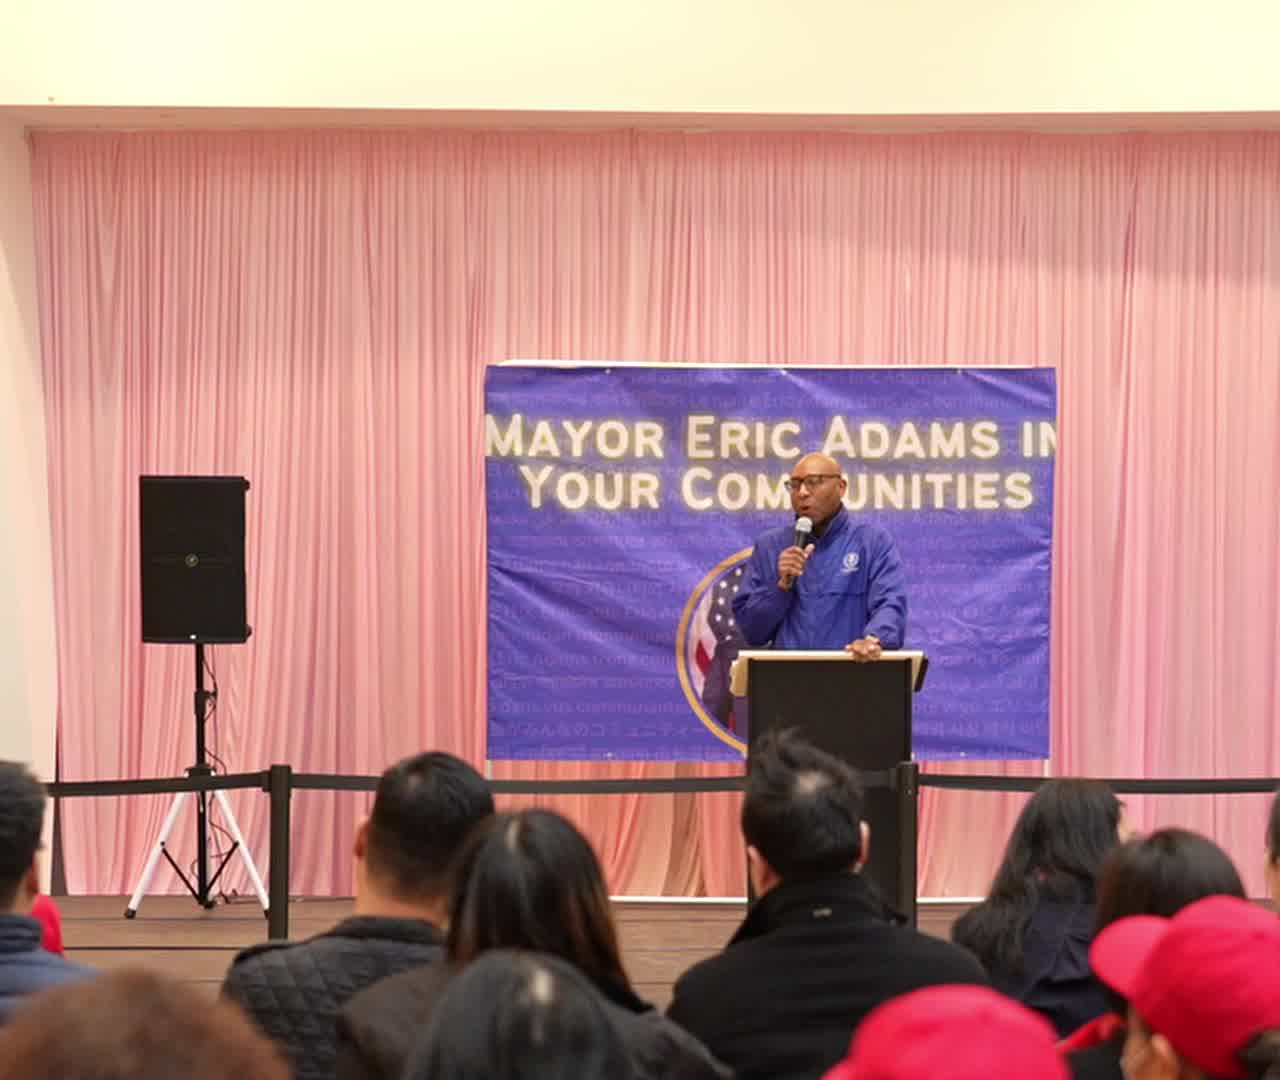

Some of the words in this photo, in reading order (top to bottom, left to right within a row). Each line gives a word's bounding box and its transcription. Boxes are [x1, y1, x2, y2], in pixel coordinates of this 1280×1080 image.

[485, 413, 664, 458] MAYOR
[688, 415, 800, 459] ERIC
[822, 415, 1000, 459] ADAMS
[520, 464, 659, 510] YOUR
[681, 466, 1033, 511] COMUNITIES
